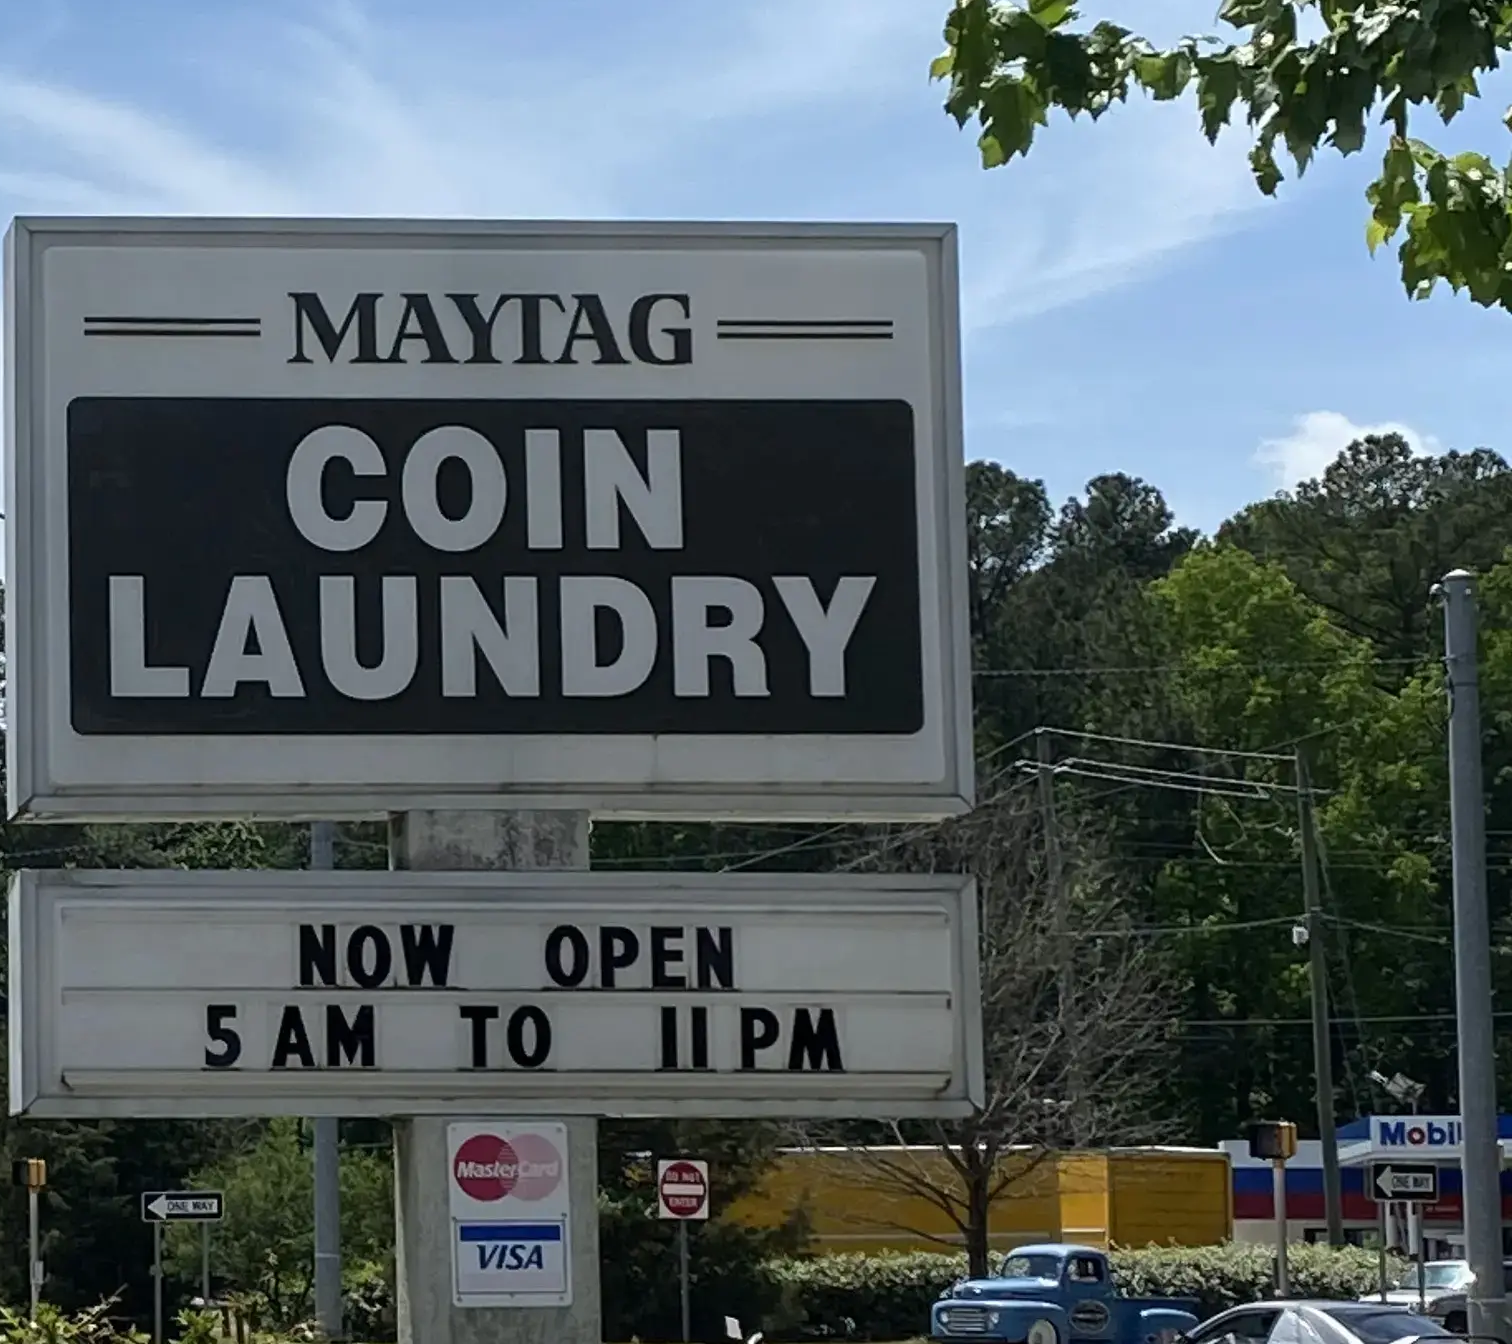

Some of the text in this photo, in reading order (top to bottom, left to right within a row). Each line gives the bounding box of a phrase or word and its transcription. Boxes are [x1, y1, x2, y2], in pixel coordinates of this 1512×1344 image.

[286, 292, 693, 366] MAYTAG
[287, 424, 683, 552] COIN
[108, 574, 877, 700] LAUNDRY
[299, 923, 734, 989] NOW OPEN
[204, 1004, 241, 1068] 5
[272, 1004, 376, 1068] AM
[459, 1004, 552, 1068] TO
[740, 1006, 844, 1070] PM
[457, 1160, 561, 1178] MasterCard
[168, 1201, 214, 1212] ONE WAY
[477, 1244, 543, 1271] VISA
